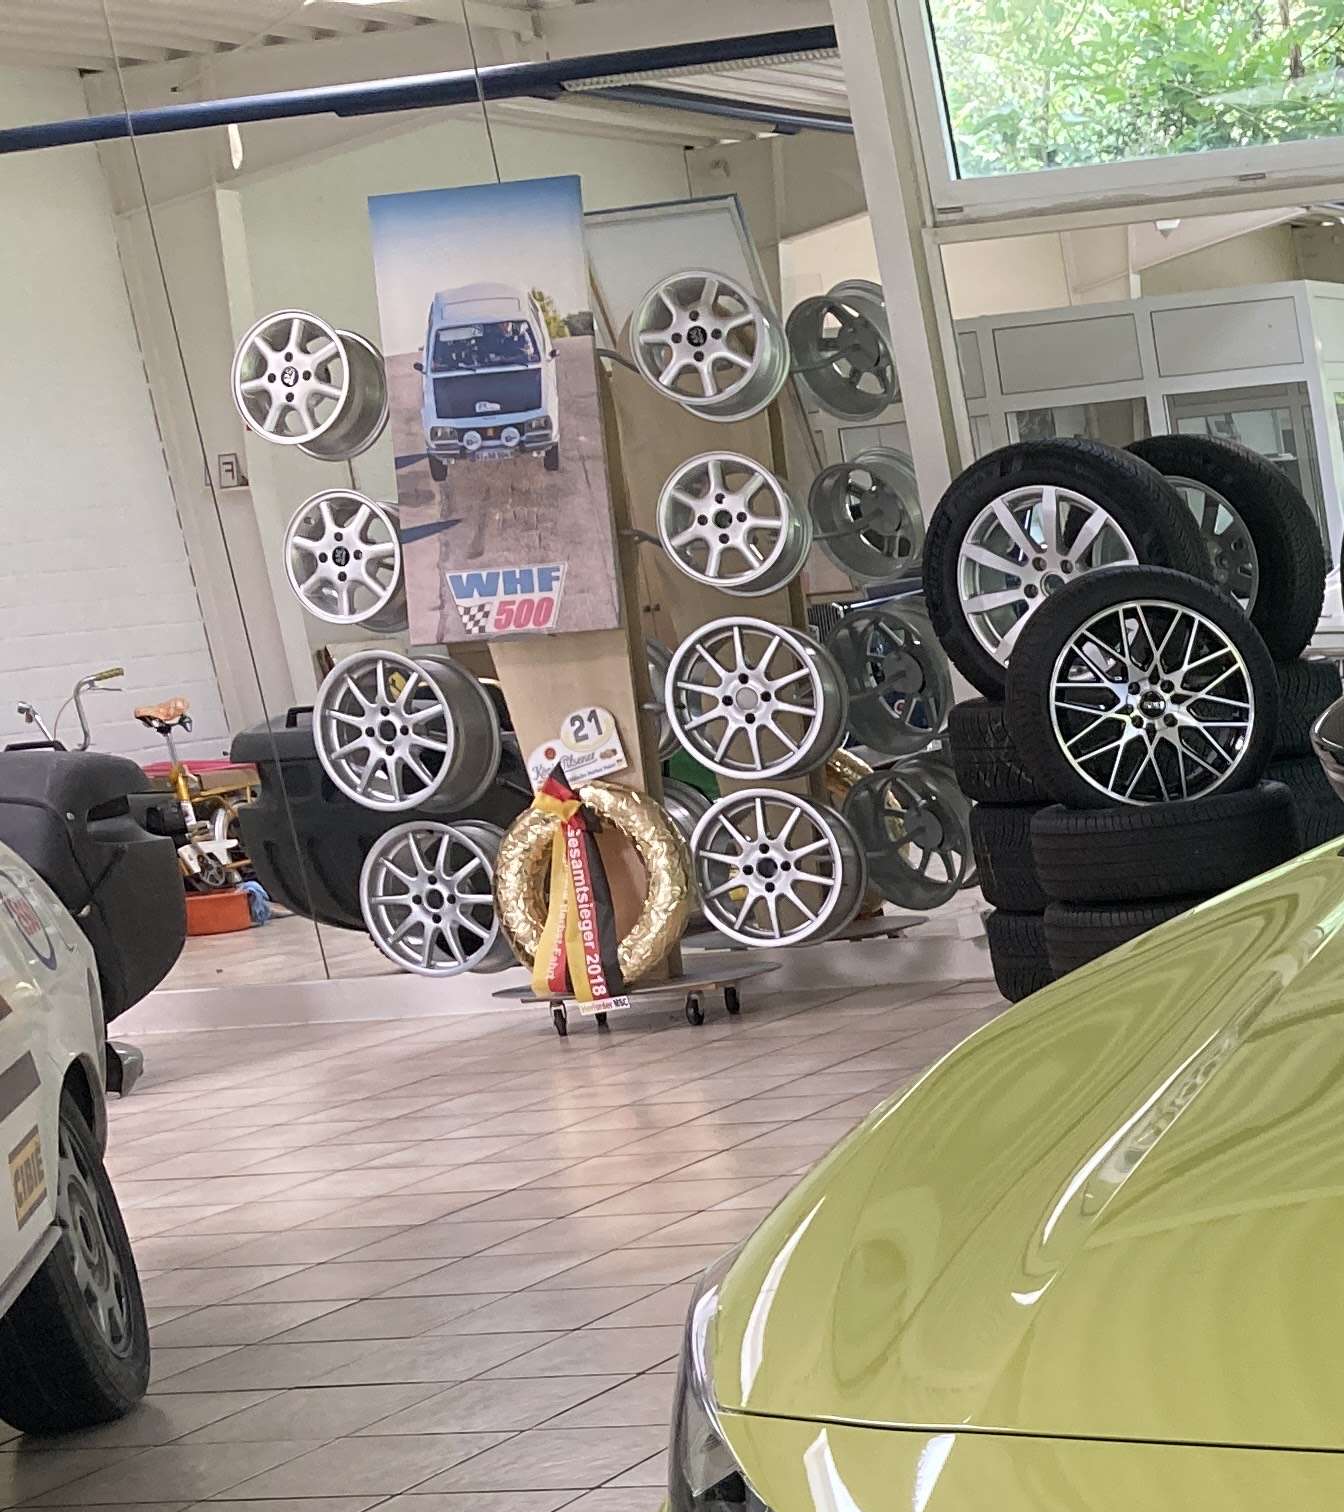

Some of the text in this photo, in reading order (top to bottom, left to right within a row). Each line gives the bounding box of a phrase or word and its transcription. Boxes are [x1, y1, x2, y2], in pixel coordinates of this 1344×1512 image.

[448, 566, 561, 600] WHF
[494, 597, 554, 630] 500
[569, 709, 603, 743] 21
[586, 953, 607, 997] 2018
